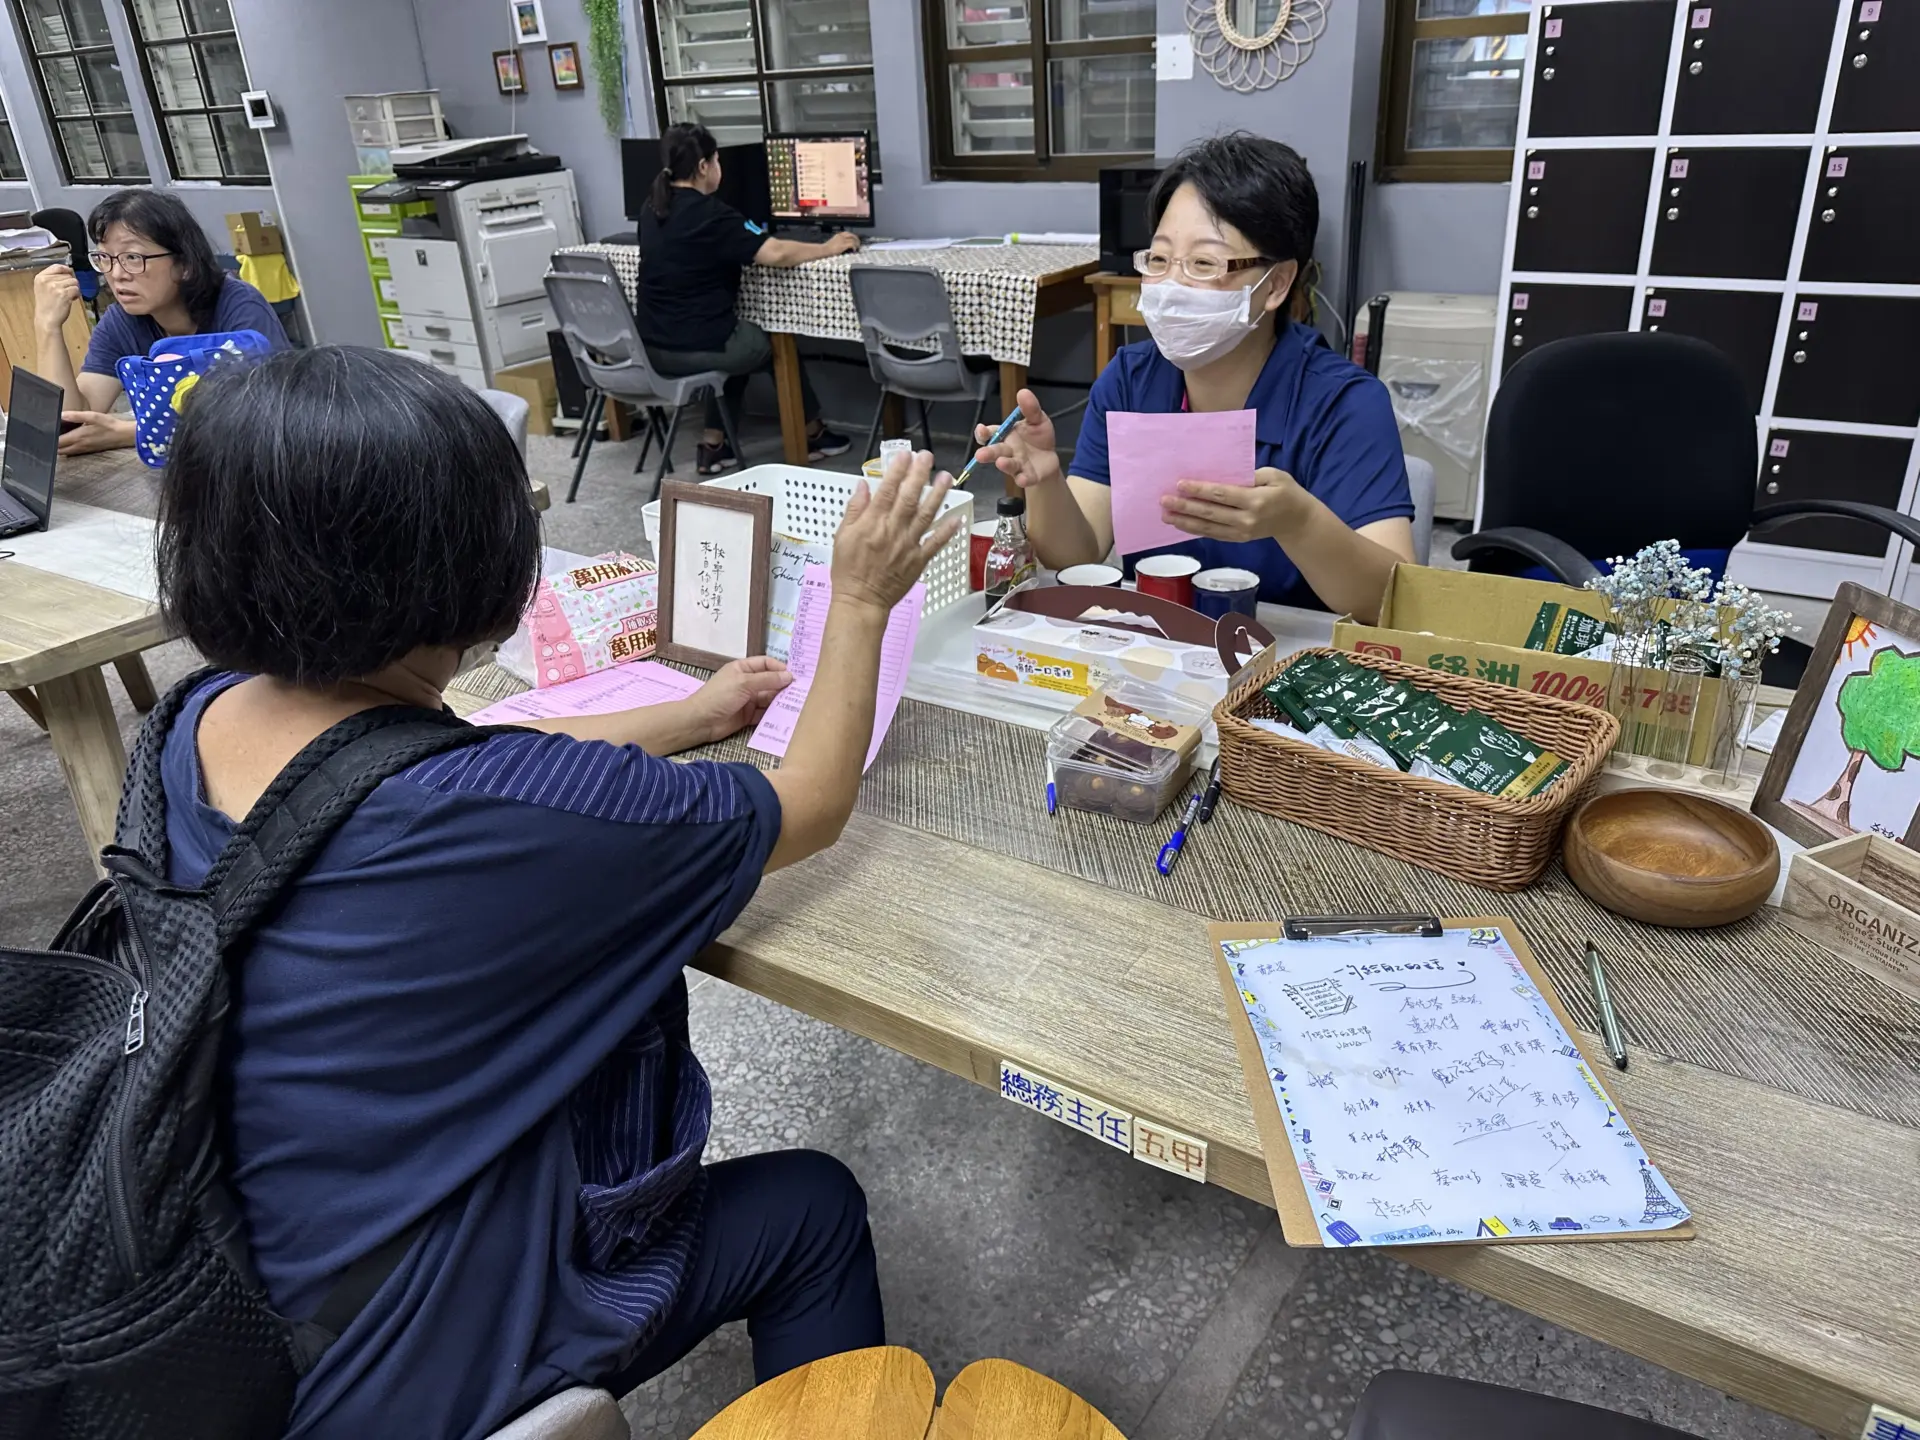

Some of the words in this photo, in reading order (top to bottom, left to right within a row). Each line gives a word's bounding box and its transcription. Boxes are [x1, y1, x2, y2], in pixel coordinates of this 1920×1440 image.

[1532, 671, 1607, 708] 100%
[1440, 752, 1455, 764] UCC
[1449, 746, 1483, 775] 職人の
[1466, 760, 1495, 786] 珈琲
[1828, 894, 1920, 957] ORGANIZ
[1838, 934, 1853, 946] INTO
[1853, 943, 1865, 953] THE
[1859, 939, 1871, 949] PUT
[1871, 945, 1889, 958] YOUR
[1889, 955, 1909, 971] ITEMS
[1876, 937, 1901, 956] Stuff
[1001, 1068, 1128, 1148] 總務主任
[1137, 1127, 1203, 1172] 五甲
[1384, 1233, 1404, 1241] Have
[1416, 1229, 1442, 1239] lovely
[1446, 1227, 1464, 1235] day.
